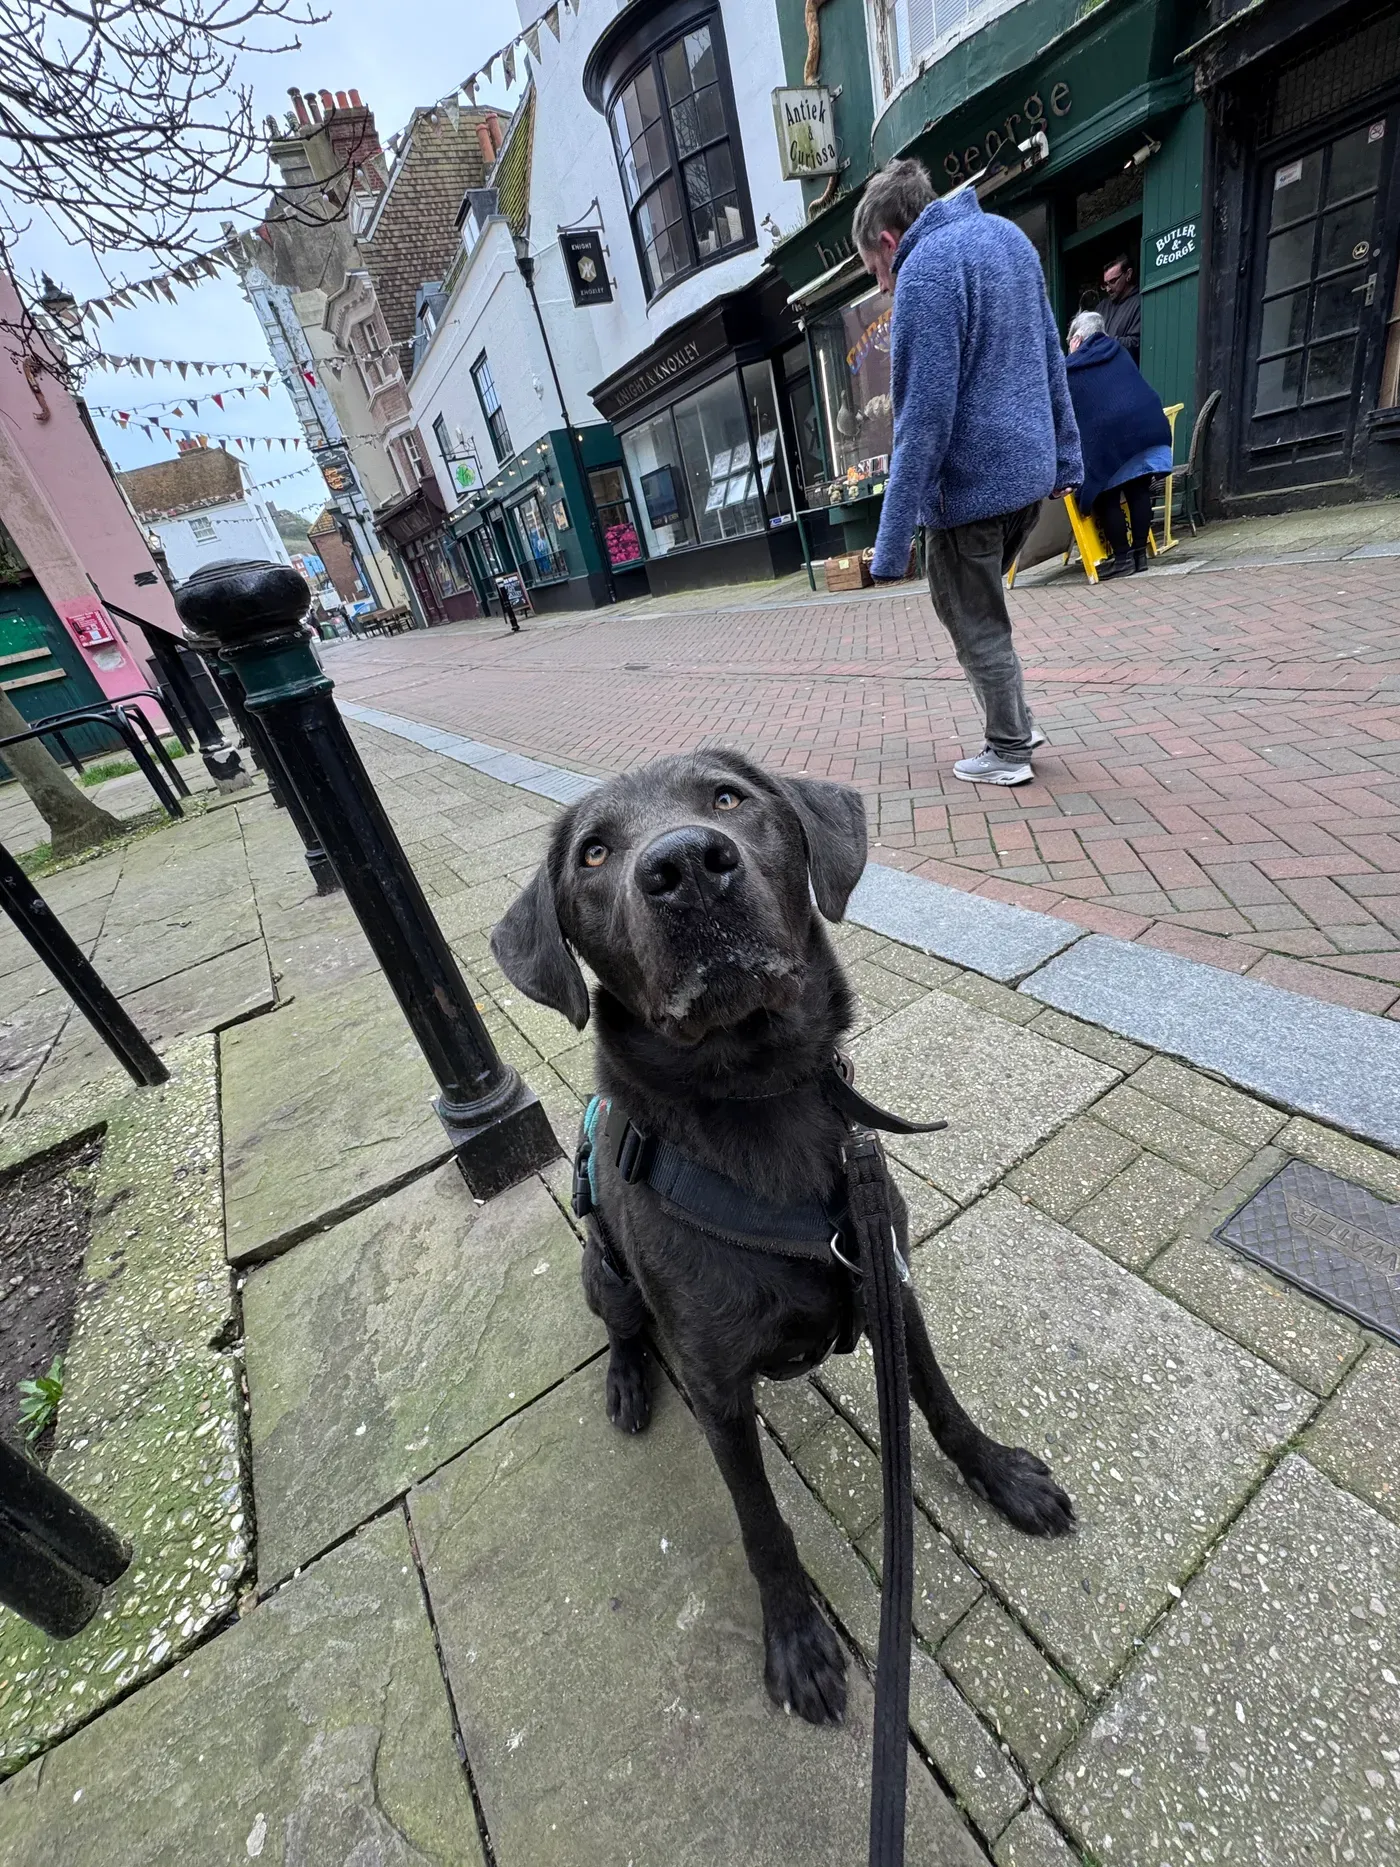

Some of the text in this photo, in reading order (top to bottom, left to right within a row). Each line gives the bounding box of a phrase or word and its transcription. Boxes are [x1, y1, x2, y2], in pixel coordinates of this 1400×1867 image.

[785, 99, 826, 127] Antiek
[808, 125, 814, 141] &
[789, 140, 836, 169] Curiosa
[571, 242, 592, 251] KNIGHT
[1155, 224, 1196, 252] BUTLER
[1171, 239, 1181, 251] &
[1155, 239, 1196, 267] GEORGE
[580, 287, 604, 296] KNOXLEY
[615, 340, 700, 407] KNIGHT & KNOXLEY
[1291, 1207, 1398, 1273] WATER
